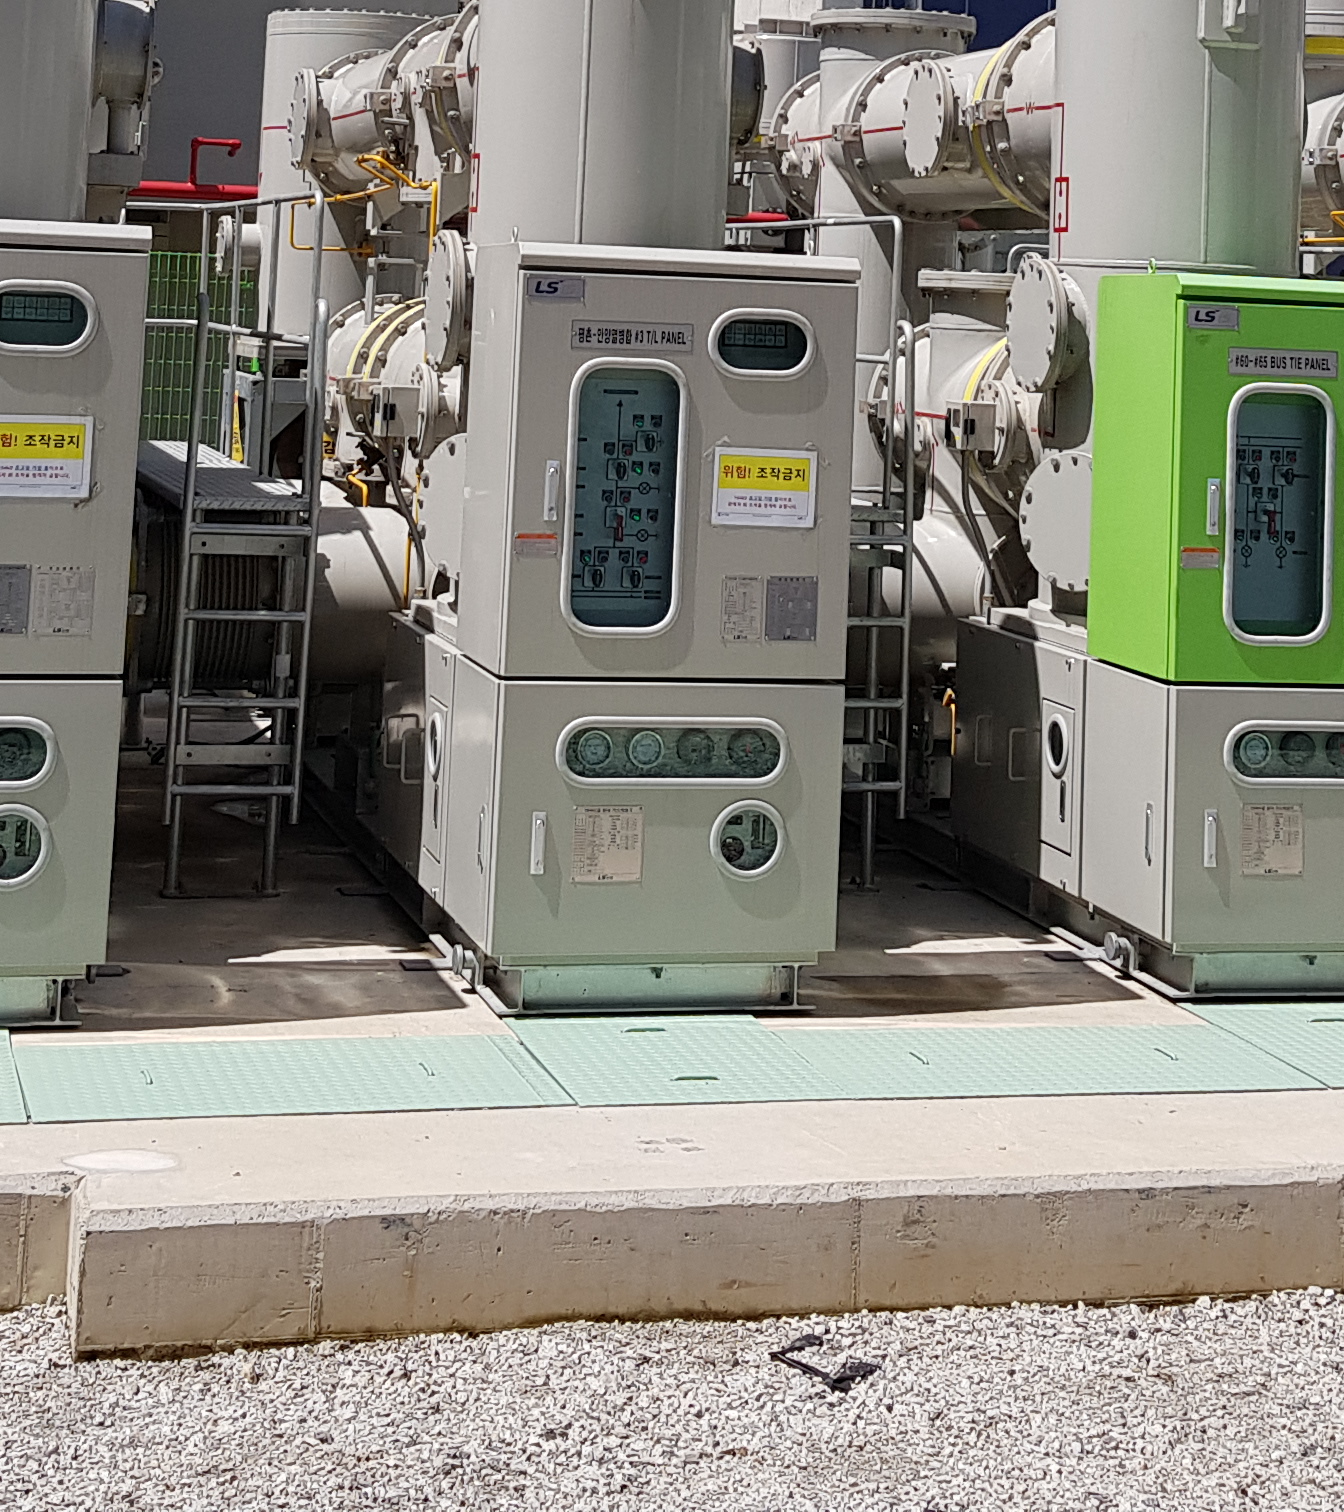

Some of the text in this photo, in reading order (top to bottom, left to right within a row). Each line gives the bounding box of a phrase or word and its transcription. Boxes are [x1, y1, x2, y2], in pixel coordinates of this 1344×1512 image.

[634, 330, 644, 343] #3
[646, 328, 658, 345] T/L
[660, 331, 686, 345] PANEL
[1270, 356, 1287, 369] BUS
[1289, 356, 1303, 370] TIE
[1305, 358, 1331, 371] PANEL
[23, 433, 80, 449] 조작금지
[756, 467, 806, 482] 조작금지
